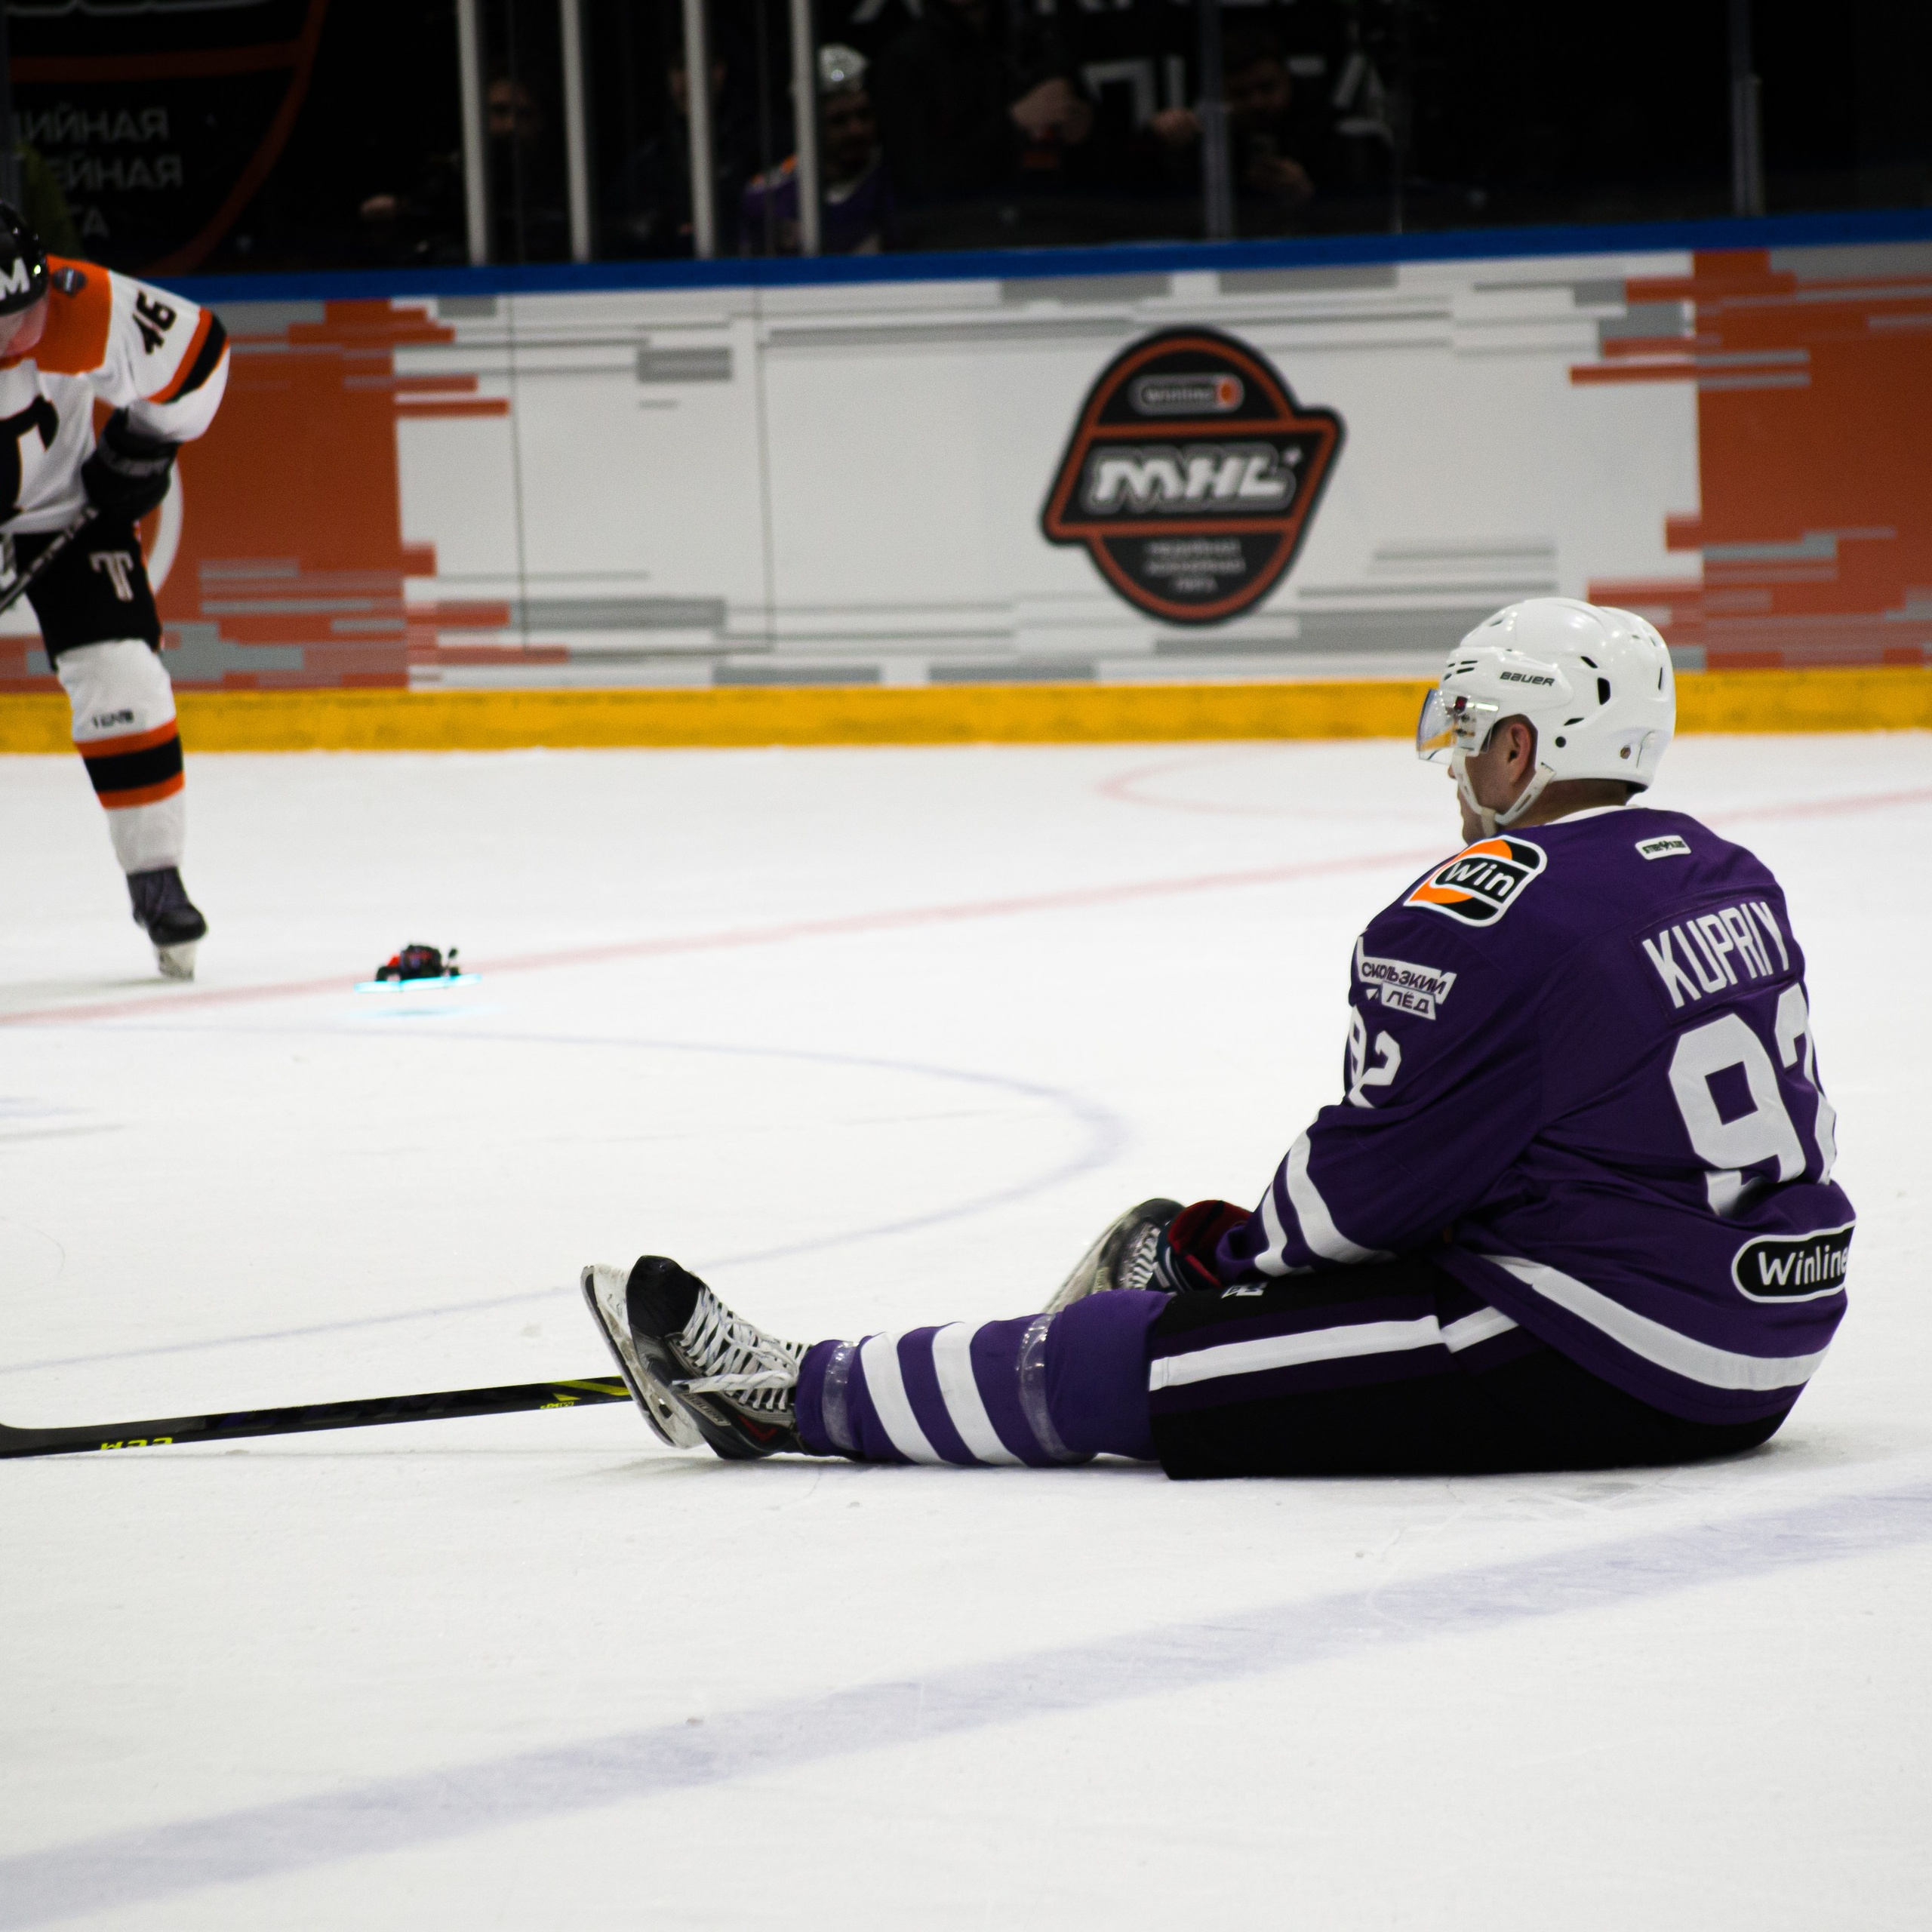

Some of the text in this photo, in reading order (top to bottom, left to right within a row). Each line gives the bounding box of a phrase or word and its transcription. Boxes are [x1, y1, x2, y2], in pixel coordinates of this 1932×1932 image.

[1500, 671, 1555, 687] BAUER
[1444, 860, 1515, 897] Win
[1642, 901, 1789, 1009] KUPRIY
[1386, 990, 1430, 1014] ЛЁД
[1349, 1006, 1401, 1109] 92
[1669, 983, 1837, 1217] 92
[1758, 1245, 1848, 1286] Winline
